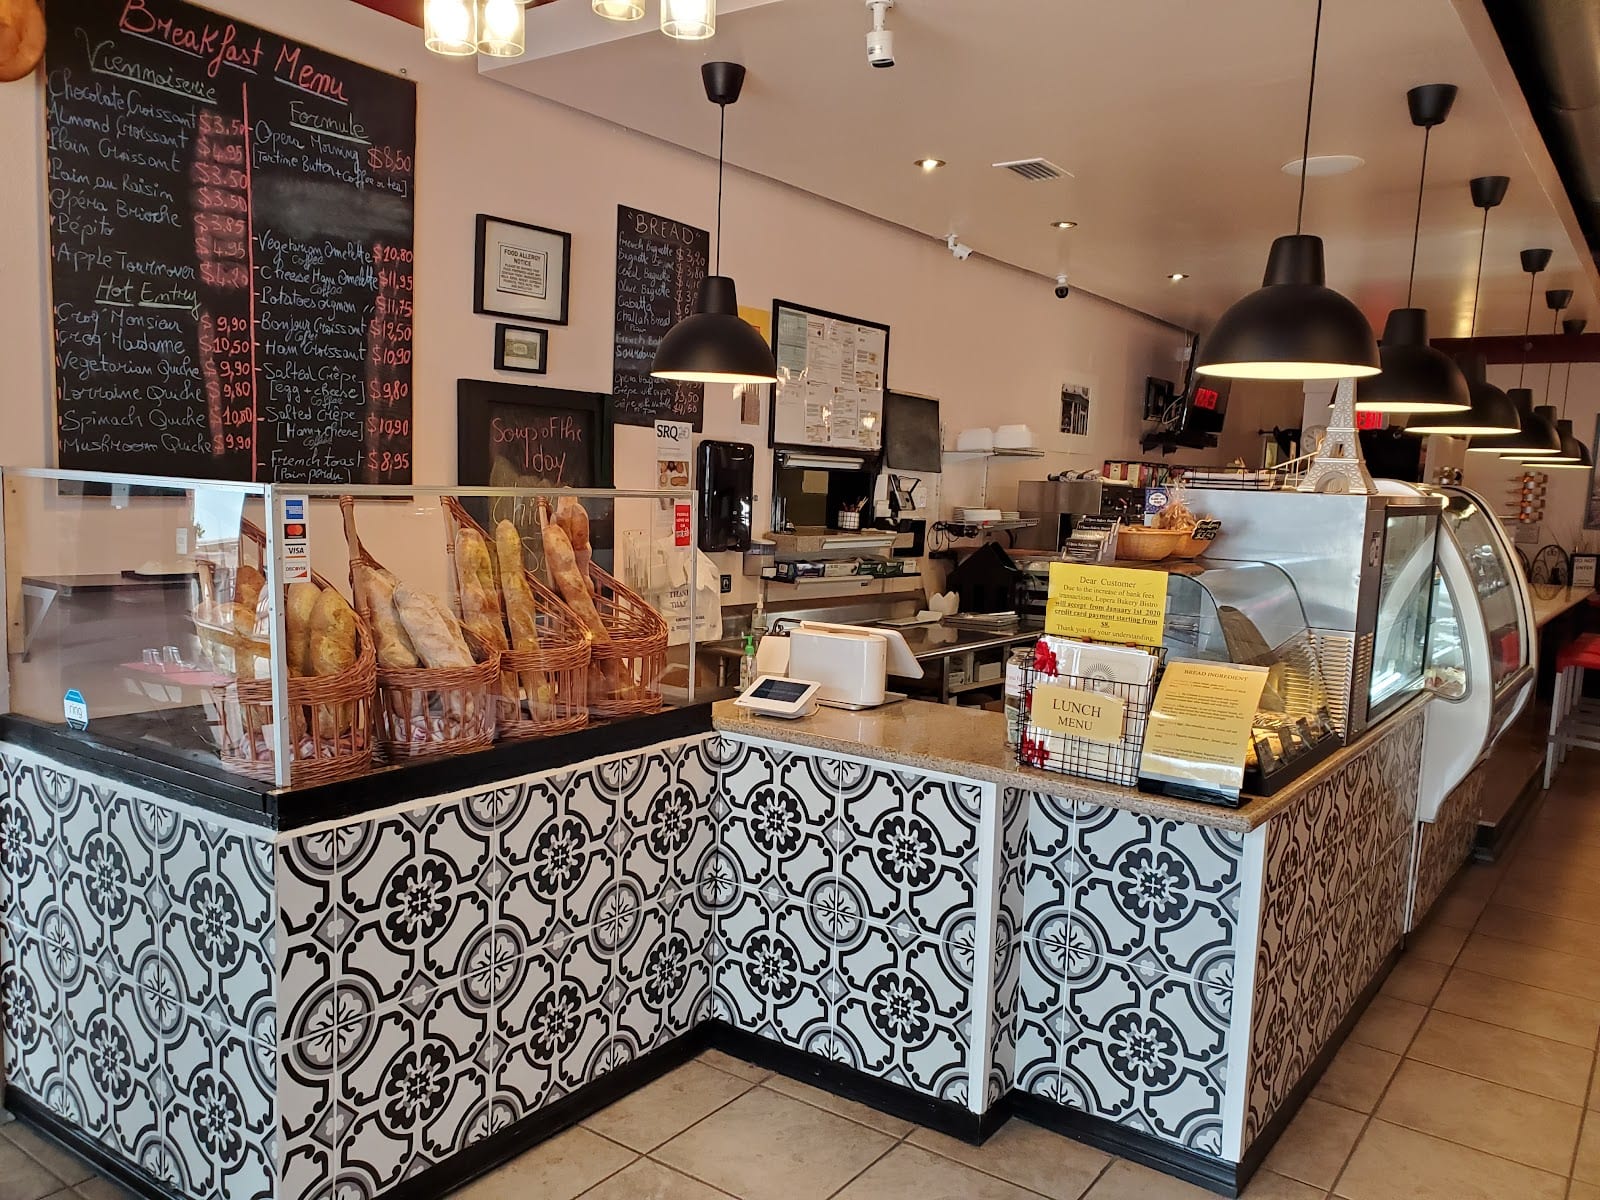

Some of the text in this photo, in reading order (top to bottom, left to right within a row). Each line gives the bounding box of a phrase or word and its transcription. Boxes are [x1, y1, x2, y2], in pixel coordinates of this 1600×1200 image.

[119, 0, 349, 101] Breakfast Menu
[50, 68, 125, 110] Chocolate
[290, 101, 369, 139] Formule
[255, 120, 304, 152] Opera
[97, 278, 134, 302] Hot
[657, 424, 679, 441] SRQ
[288, 547, 305, 555] VISA
[1080, 576, 1137, 588] Dear Customer
[1063, 584, 1075, 592] Due
[1093, 588, 1119, 596] increase
[1126, 590, 1140, 598] bank
[1055, 600, 1067, 608] will
[1067, 602, 1086, 610] accept
[1089, 603, 1105, 611] from
[1106, 605, 1131, 615] January
[1145, 609, 1161, 617] 2020
[1117, 598, 1138, 607] Bakery
[1139, 600, 1158, 608] Bistro
[1055, 608, 1158, 625] credit card payment starting from
[1056, 624, 1074, 632] Thank
[1075, 626, 1087, 634] you
[1087, 626, 1097, 634] for
[1097, 628, 1112, 637] your
[1184, 669, 1249, 681] BREAD INGREDIENT
[1053, 698, 1101, 718] LUNCH
[1058, 715, 1093, 731] MENU
